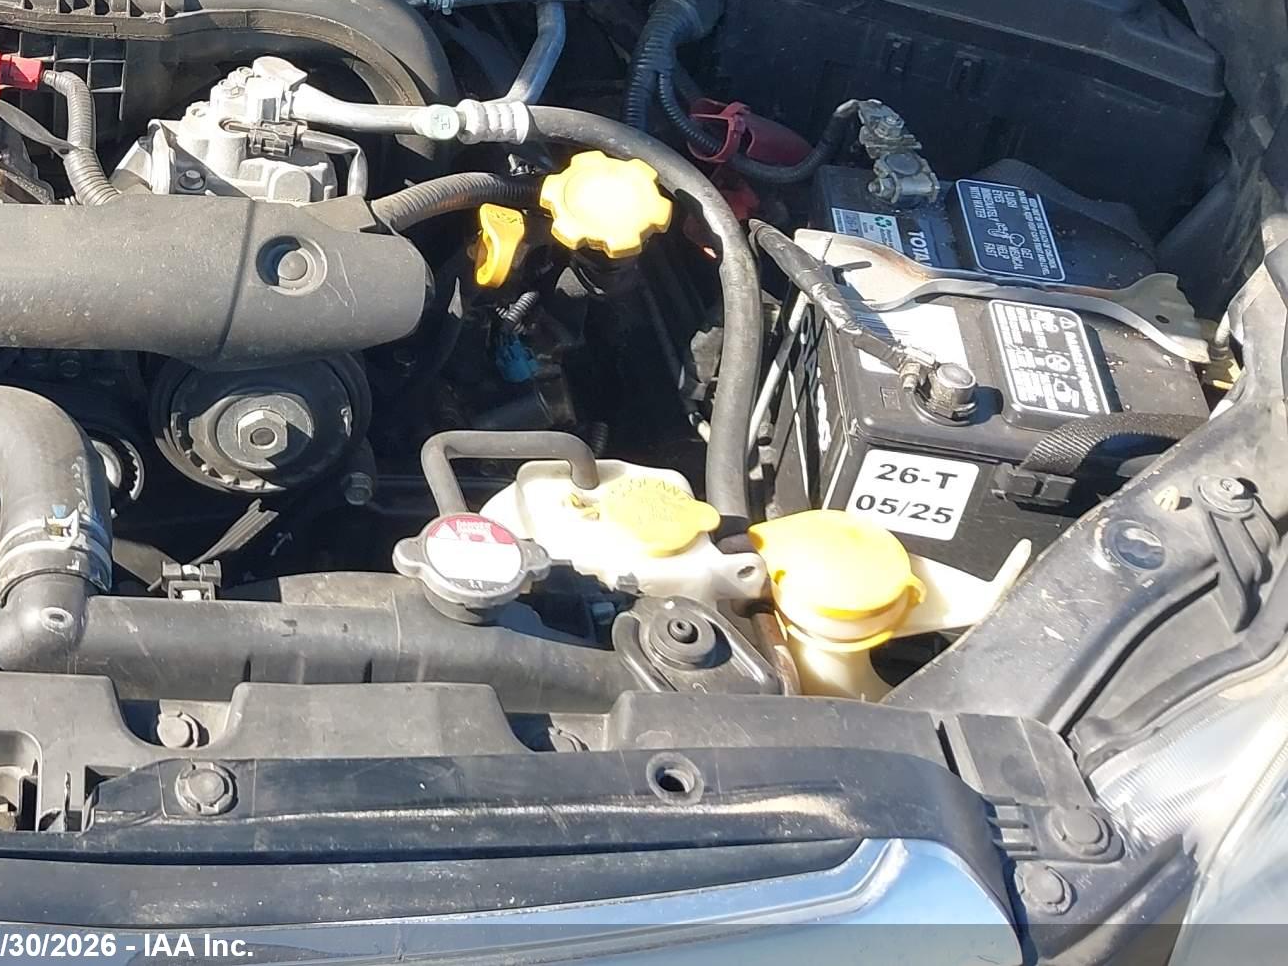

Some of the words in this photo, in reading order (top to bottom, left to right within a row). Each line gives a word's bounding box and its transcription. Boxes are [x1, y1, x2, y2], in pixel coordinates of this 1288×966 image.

[969, 187, 982, 199] WITH
[992, 190, 1003, 203] EYES
[1004, 191, 1018, 208] FLUSH
[972, 200, 986, 218] WATER
[984, 243, 998, 257] FAST
[996, 244, 1010, 259] HELP
[1008, 246, 1024, 269] MEDICAL
[1021, 248, 1034, 260] GET
[874, 464, 958, 489] 26-T
[856, 495, 954, 524] 05/25
